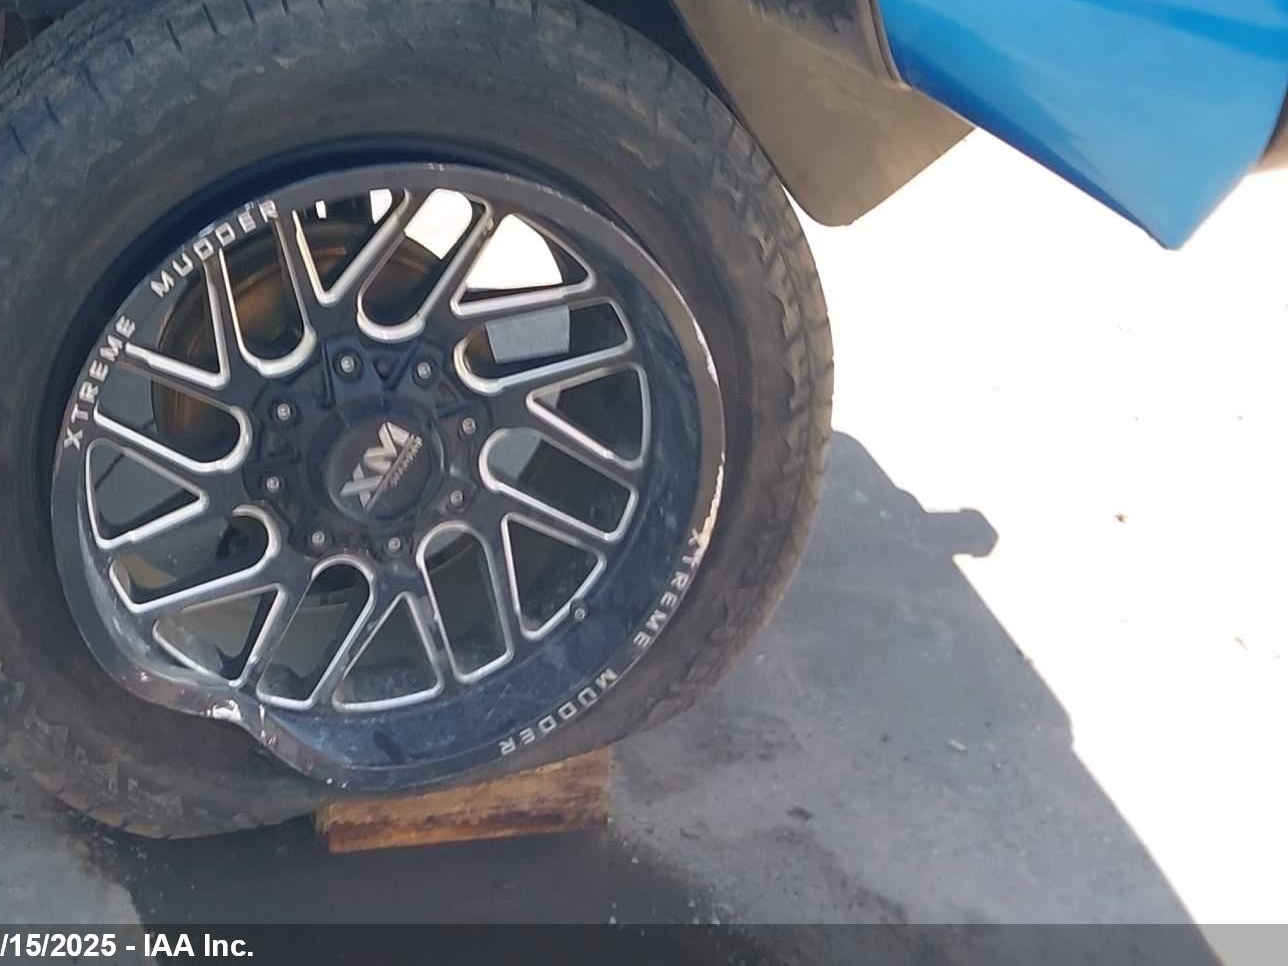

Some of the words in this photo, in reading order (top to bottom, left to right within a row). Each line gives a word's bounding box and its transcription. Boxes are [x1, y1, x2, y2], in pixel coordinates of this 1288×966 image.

[63, 315, 136, 450] XTREME
[151, 199, 279, 298] MUDDER
[633, 527, 705, 648] XTREME
[498, 668, 617, 755] MUDDER
